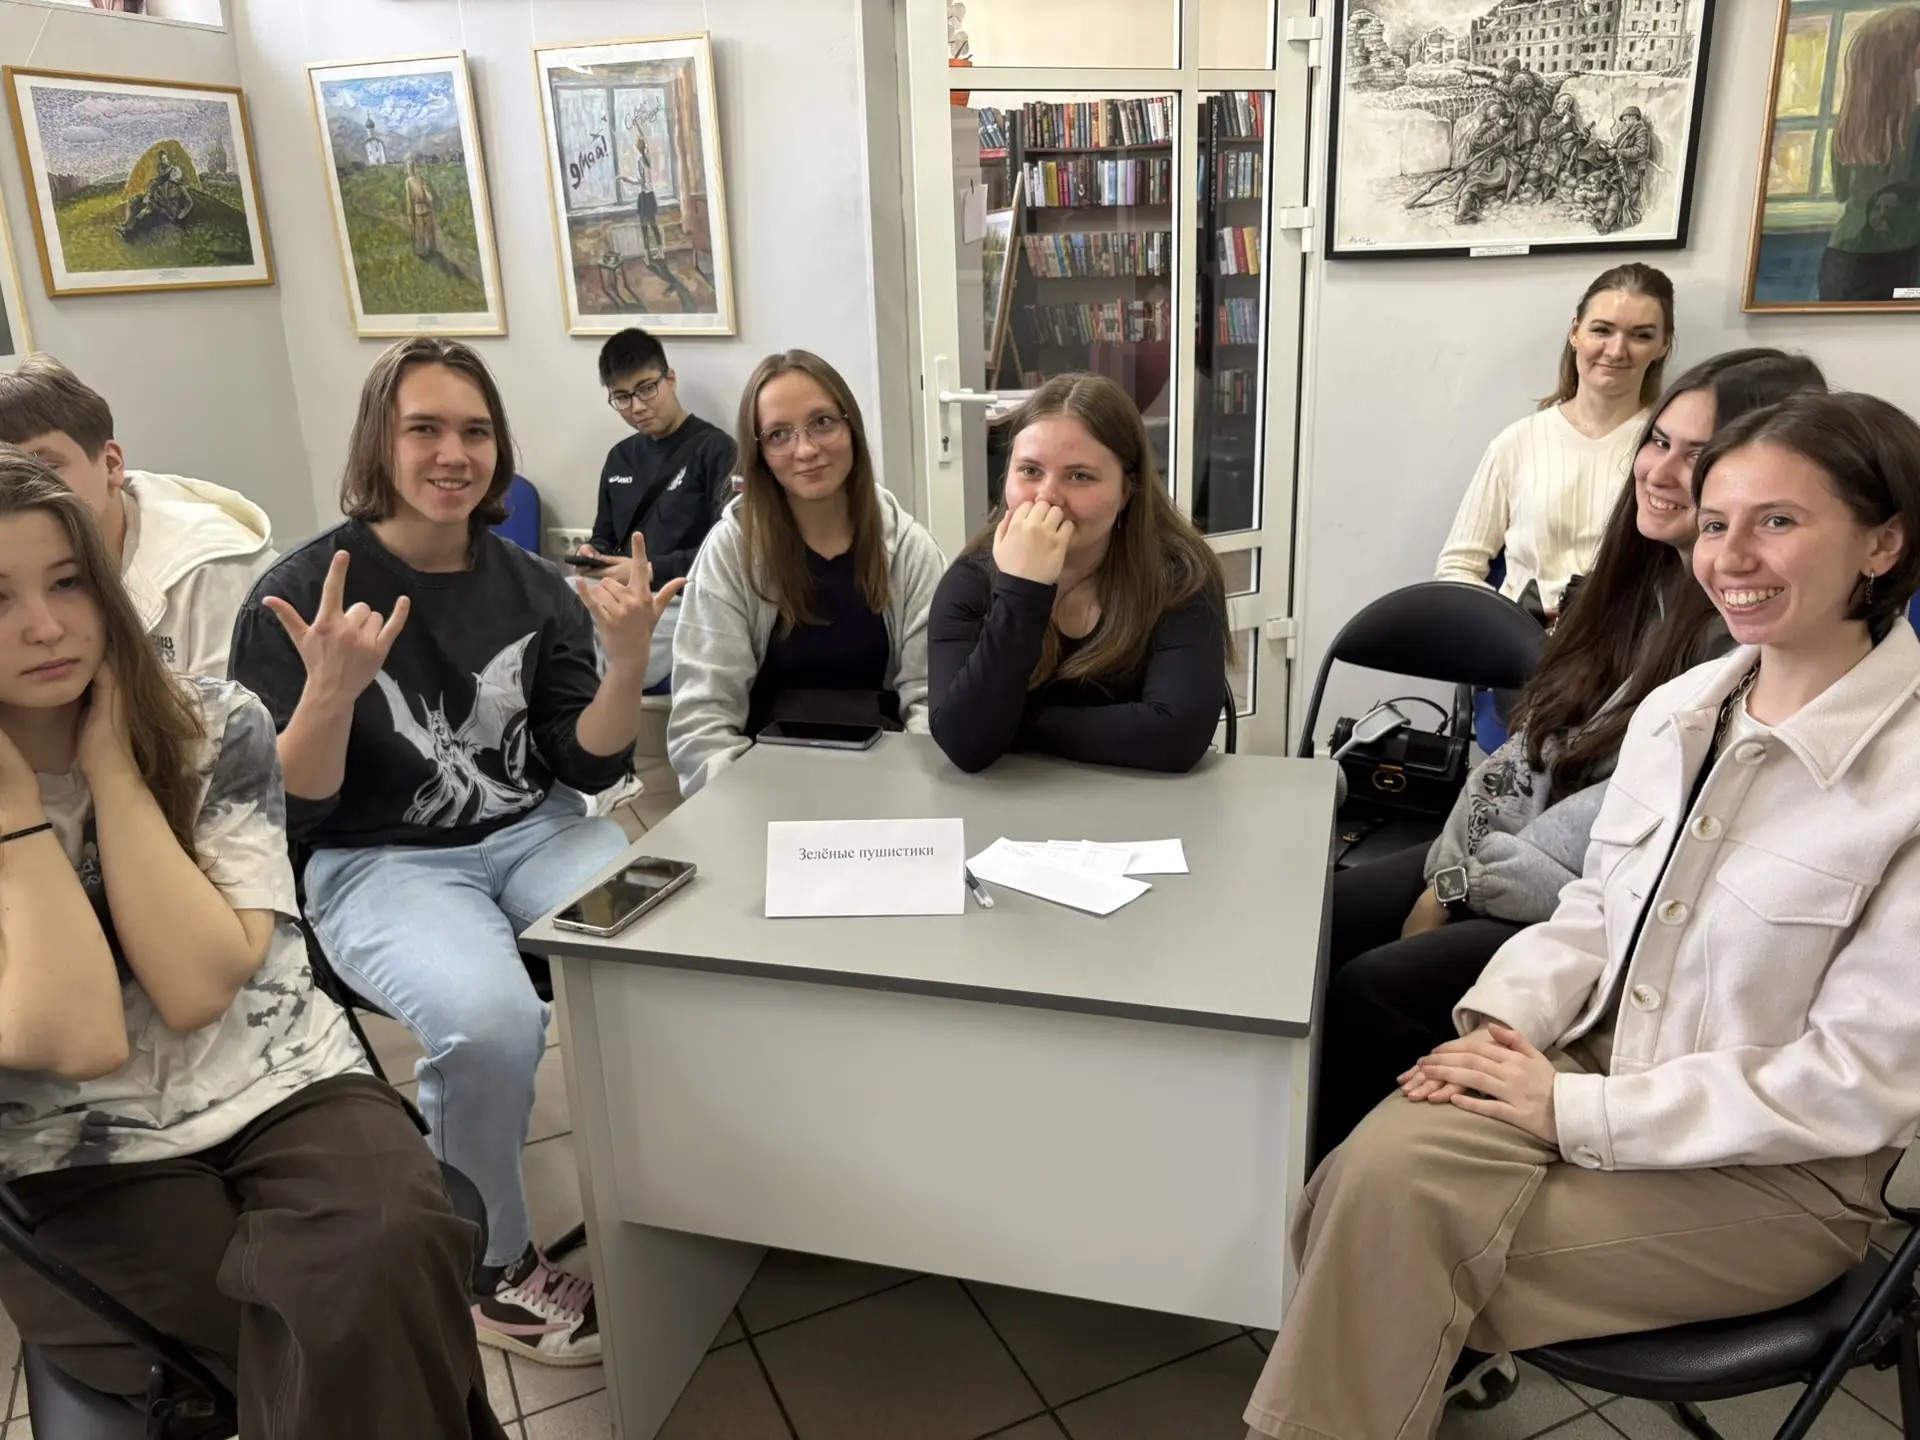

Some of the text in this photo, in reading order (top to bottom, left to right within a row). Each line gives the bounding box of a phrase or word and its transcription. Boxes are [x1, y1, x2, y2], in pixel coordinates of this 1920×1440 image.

[570, 162, 581, 190] 9
[798, 846, 934, 861] Зелёные пушистики
